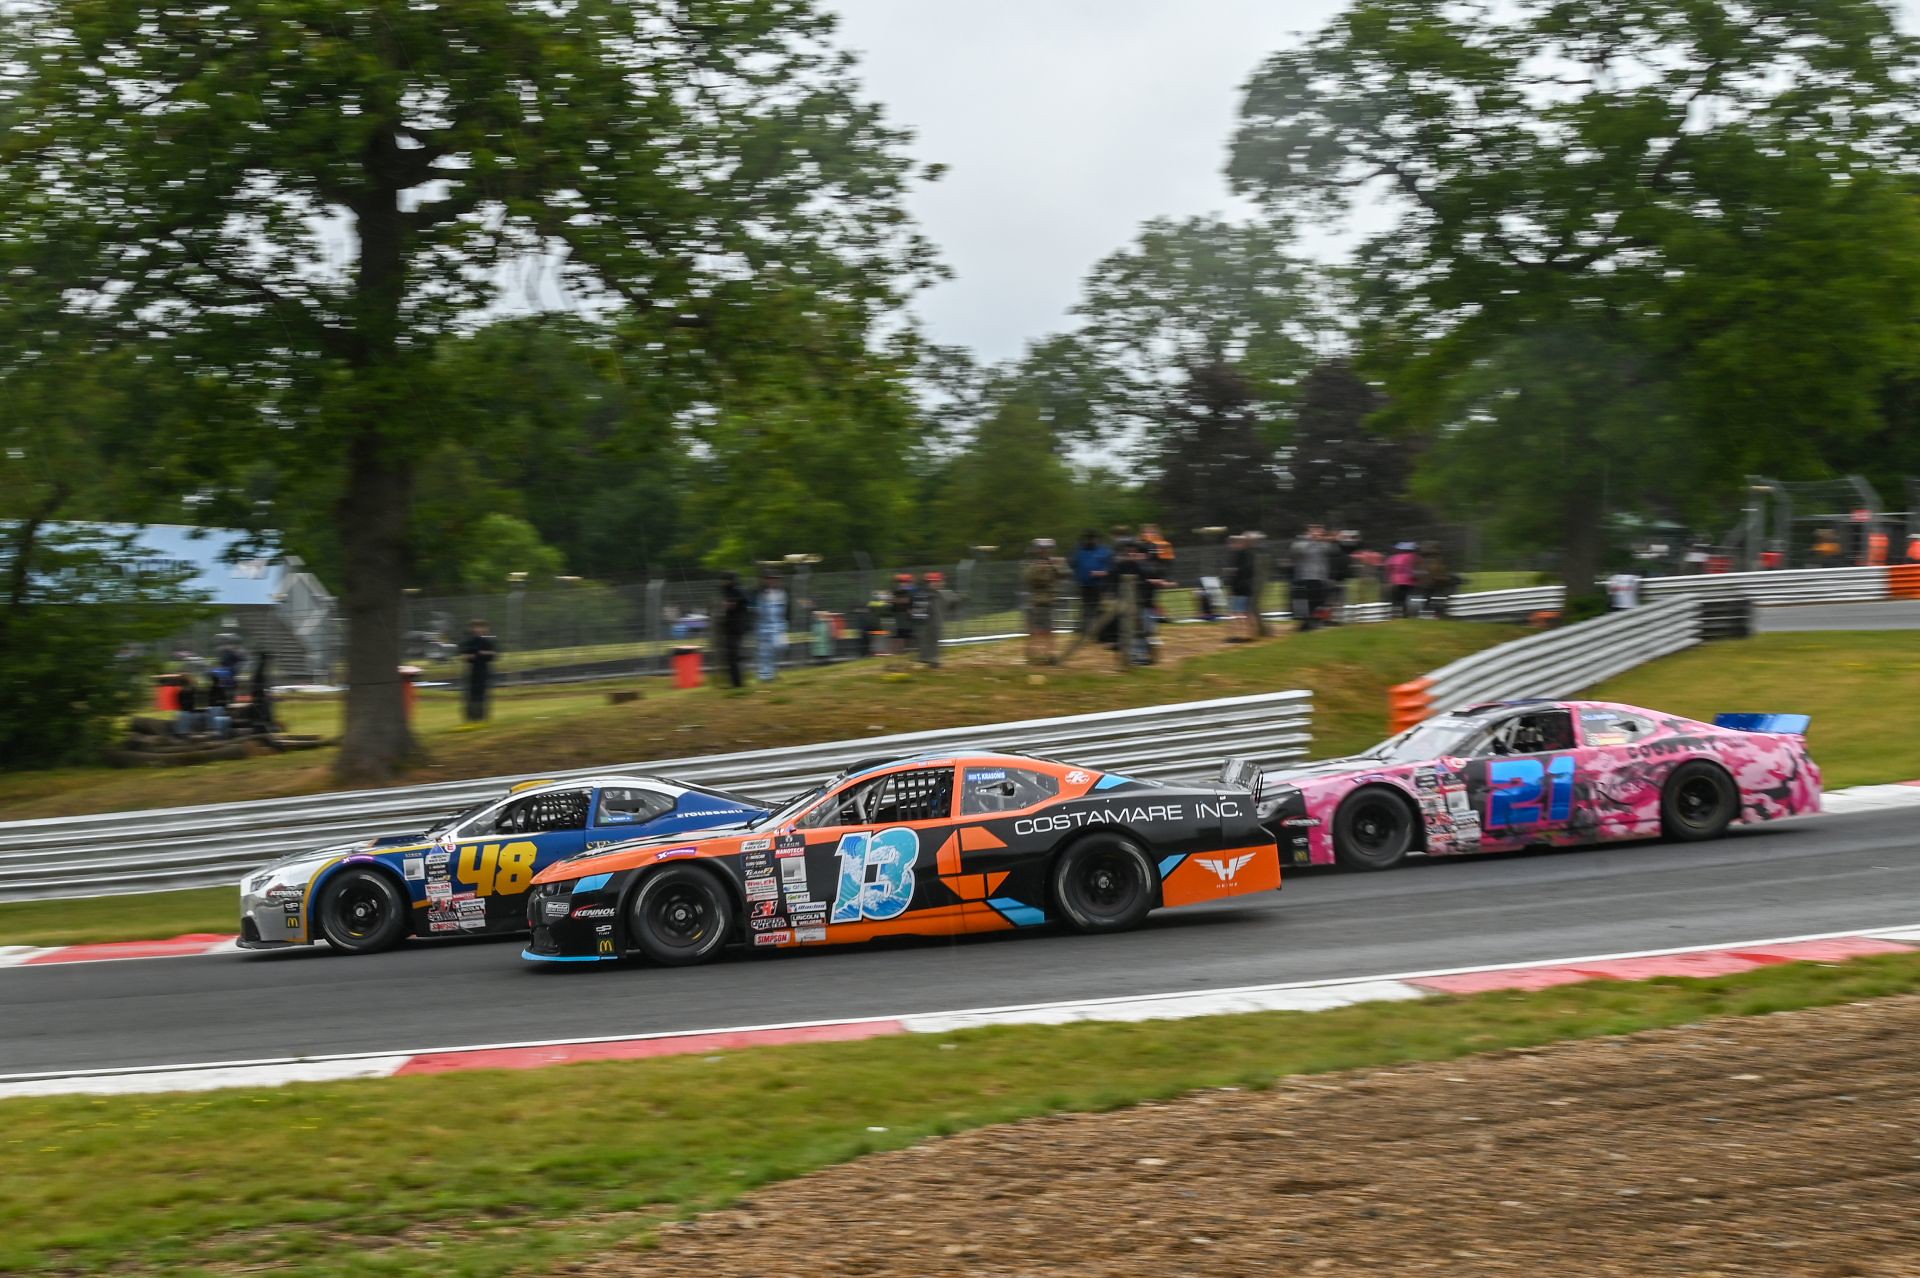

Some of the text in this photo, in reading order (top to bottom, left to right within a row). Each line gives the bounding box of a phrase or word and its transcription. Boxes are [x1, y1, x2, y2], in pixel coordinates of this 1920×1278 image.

[1487, 756, 1577, 829] 21
[684, 809, 744, 818] rousseau
[1014, 801, 1243, 835] COSTAMARE INC.
[457, 841, 537, 896] 48
[830, 826, 920, 924] 13
[574, 908, 615, 917] KENNOL
[757, 934, 787, 943] SIMPSON
